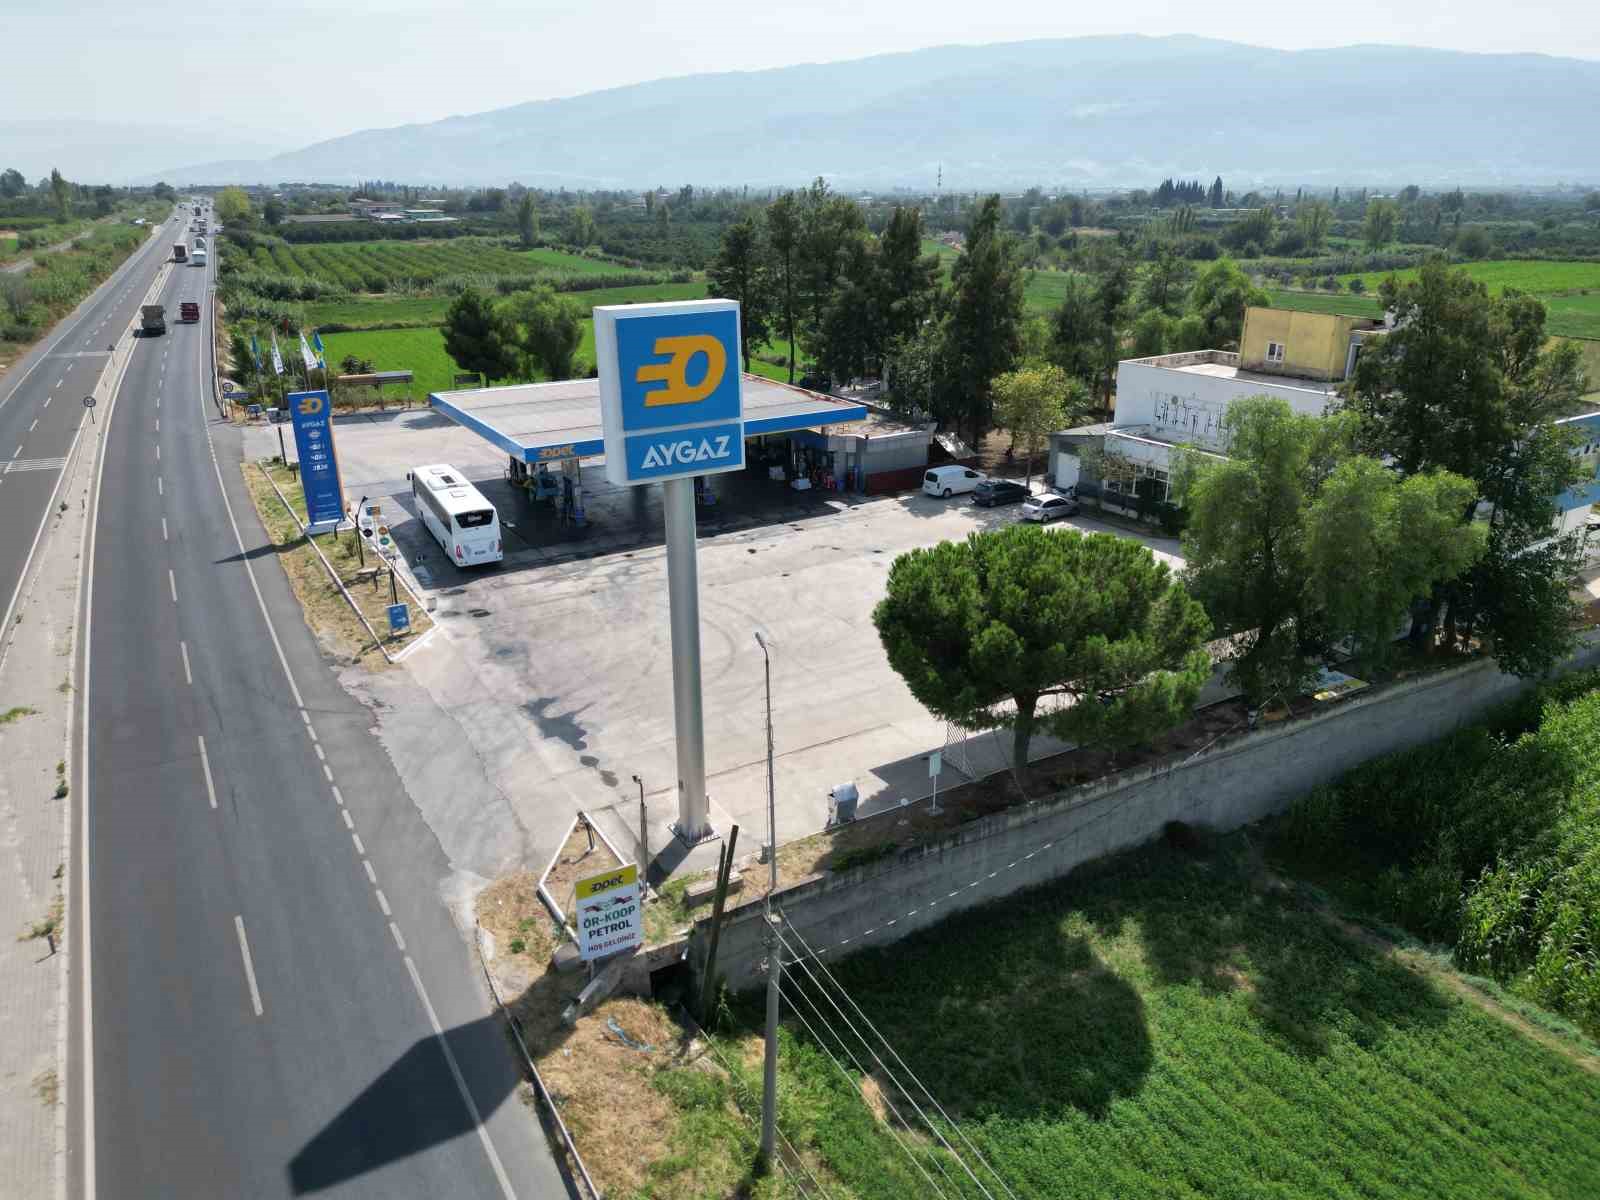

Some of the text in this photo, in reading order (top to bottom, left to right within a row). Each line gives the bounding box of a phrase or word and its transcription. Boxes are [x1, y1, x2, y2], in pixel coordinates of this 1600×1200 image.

[640, 434, 731, 469] AYGAZ
[584, 905, 635, 928] ÖR-KOOP
[588, 919, 633, 939] PETROL
